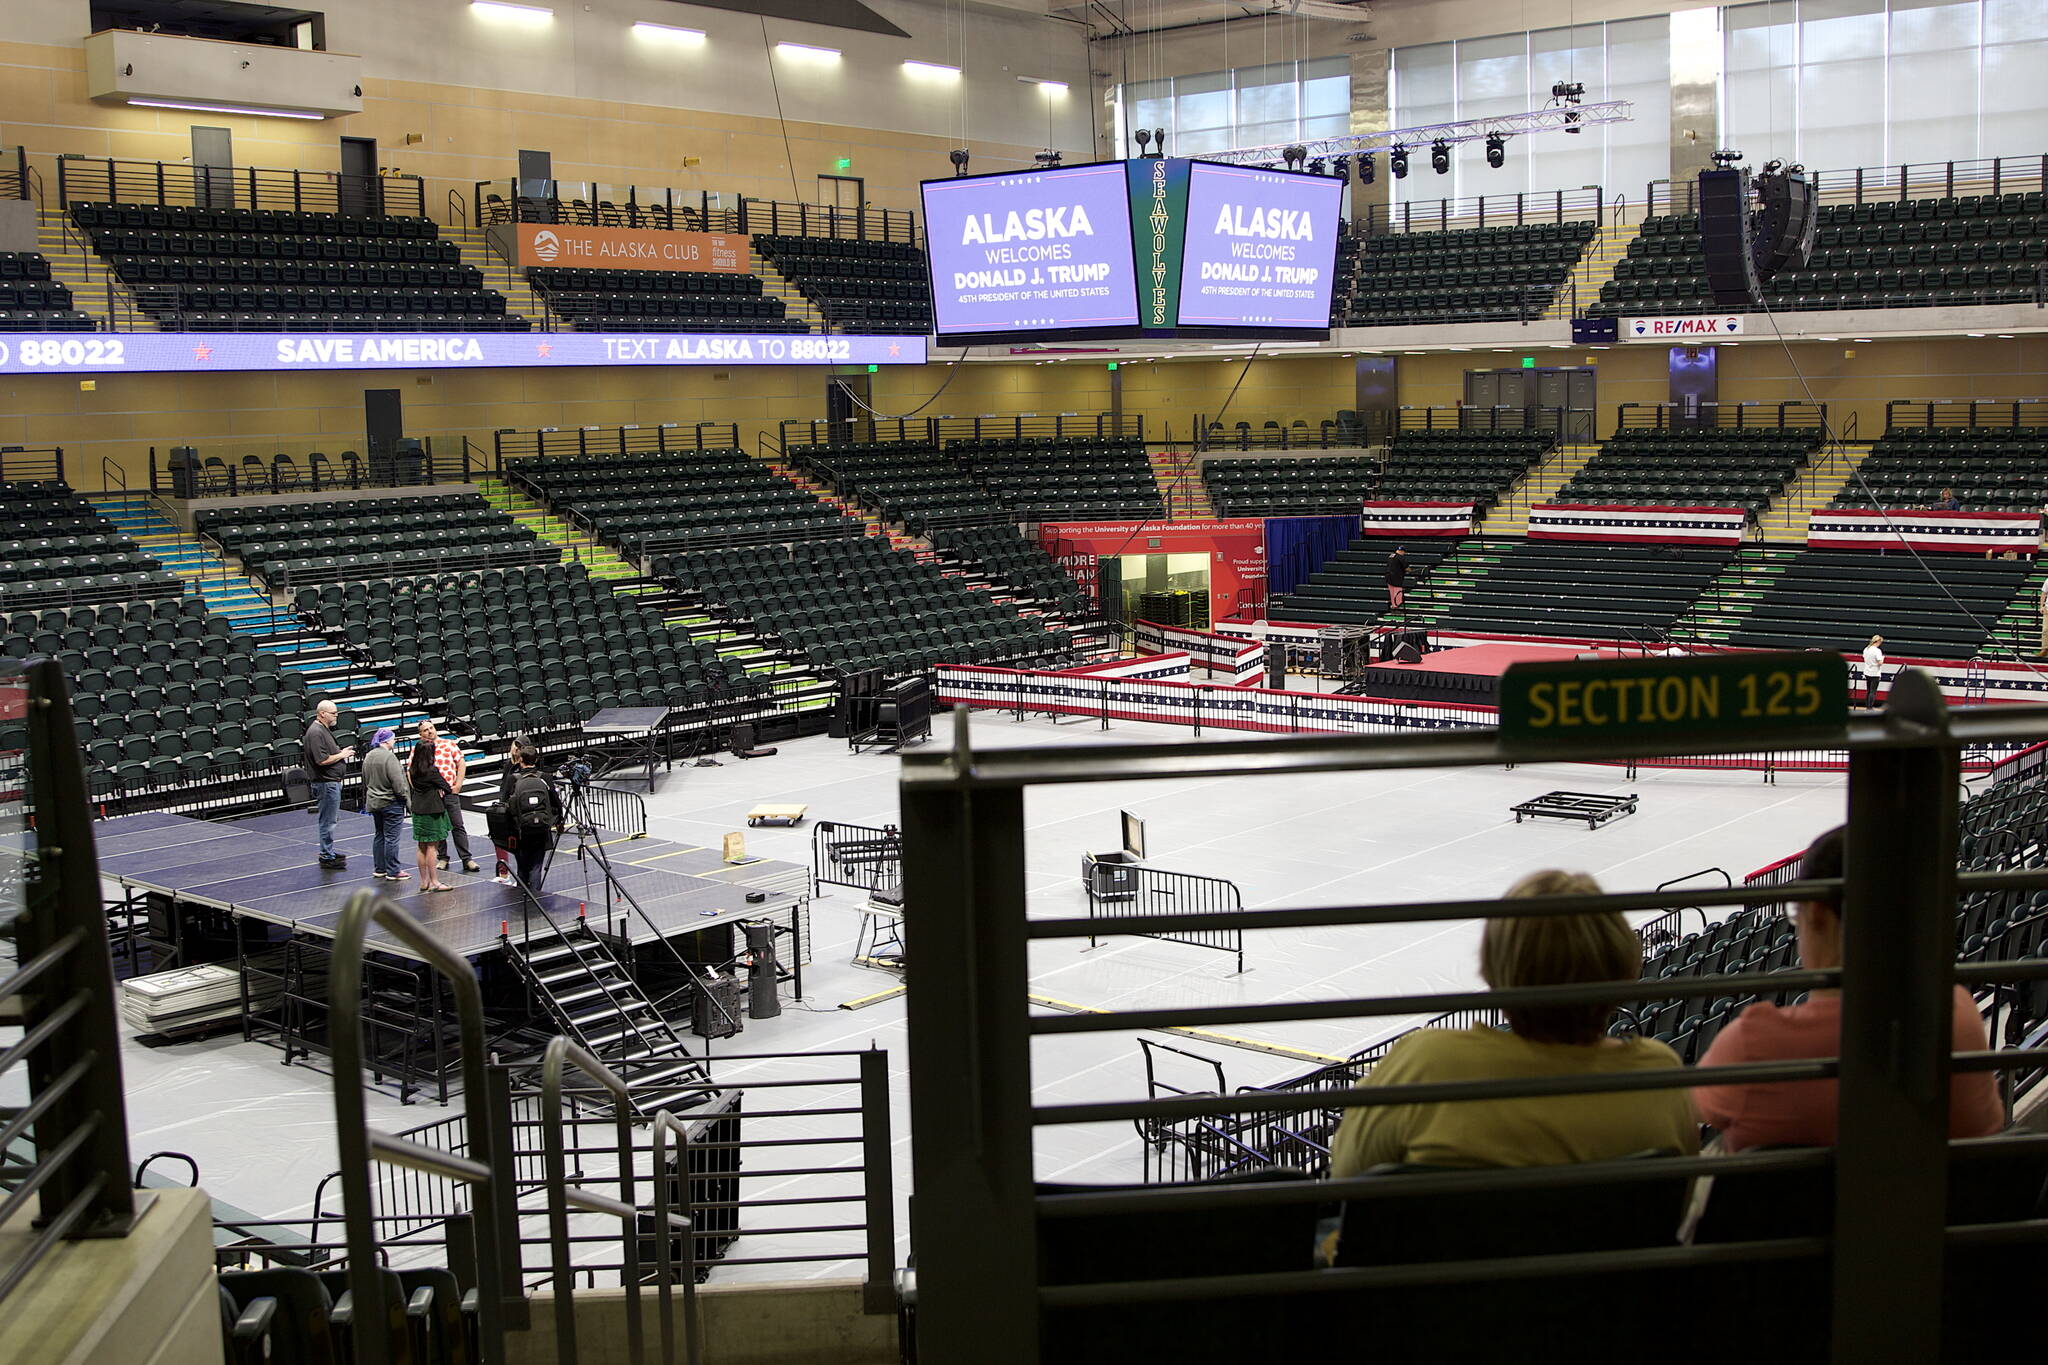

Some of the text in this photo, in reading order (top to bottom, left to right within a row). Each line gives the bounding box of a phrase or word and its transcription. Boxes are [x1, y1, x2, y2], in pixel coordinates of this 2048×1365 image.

[961, 204, 1094, 246] ALASKA
[1214, 203, 1313, 241] ALASKA
[564, 239, 700, 261] THE ALASKA CLUB
[712, 246, 737, 258] fitness
[985, 243, 1072, 265] WELCOMES
[1149, 161, 1169, 325] SEAWOLVES
[1231, 242, 1296, 261] WELCOMES
[954, 263, 1110, 290] DONALD J. TRUMP
[1201, 262, 1319, 285] DONALD J. TRUMP
[958, 286, 1110, 304] 45TH PRESIDENT OF THE UNITED STATES
[1201, 286, 1315, 299] 45TH PRESIDENT OF THE UNITED STATES
[1653, 319, 1718, 334] RE/MAX
[20, 339, 125, 366] 88022
[276, 338, 484, 363] SAVE AMERICA
[602, 338, 850, 360] TEXT ALASKA TO 88022
[1094, 525, 1129, 534] University
[1130, 525, 1137, 533] of
[1162, 523, 1200, 531] Foundation
[1229, 522, 1244, 530] than
[1528, 671, 1822, 728] SECTION 125
